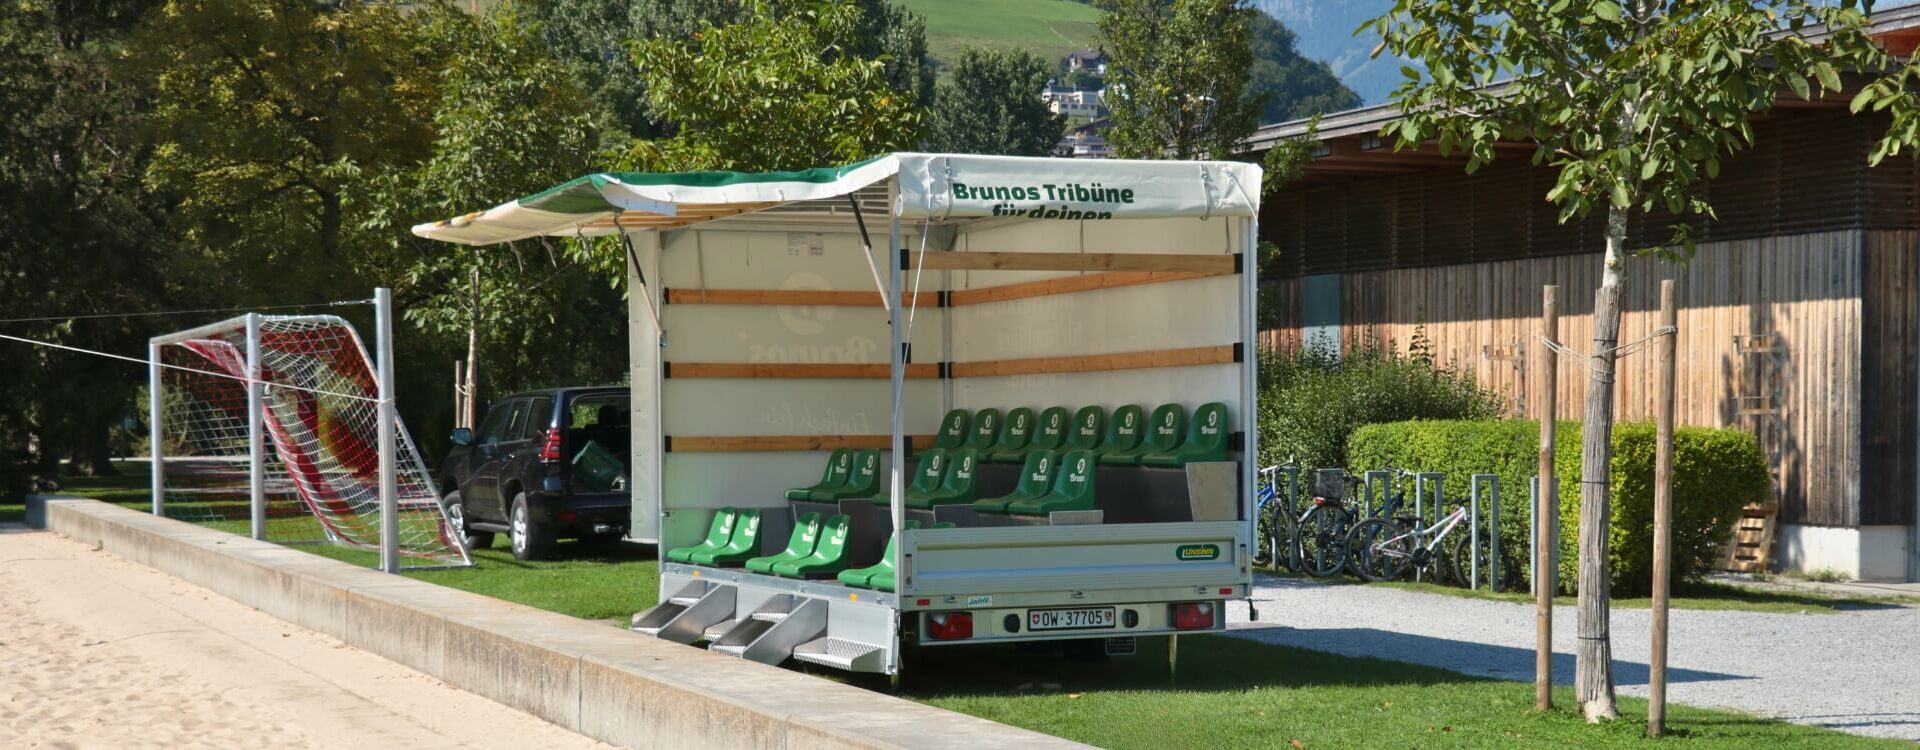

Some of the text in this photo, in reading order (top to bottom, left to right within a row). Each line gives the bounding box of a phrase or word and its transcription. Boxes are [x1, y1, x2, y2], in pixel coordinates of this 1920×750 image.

[953, 182, 1135, 204] Brunos Tribüne
[992, 203, 1026, 217] für
[1042, 610, 1103, 627] OW 37705
